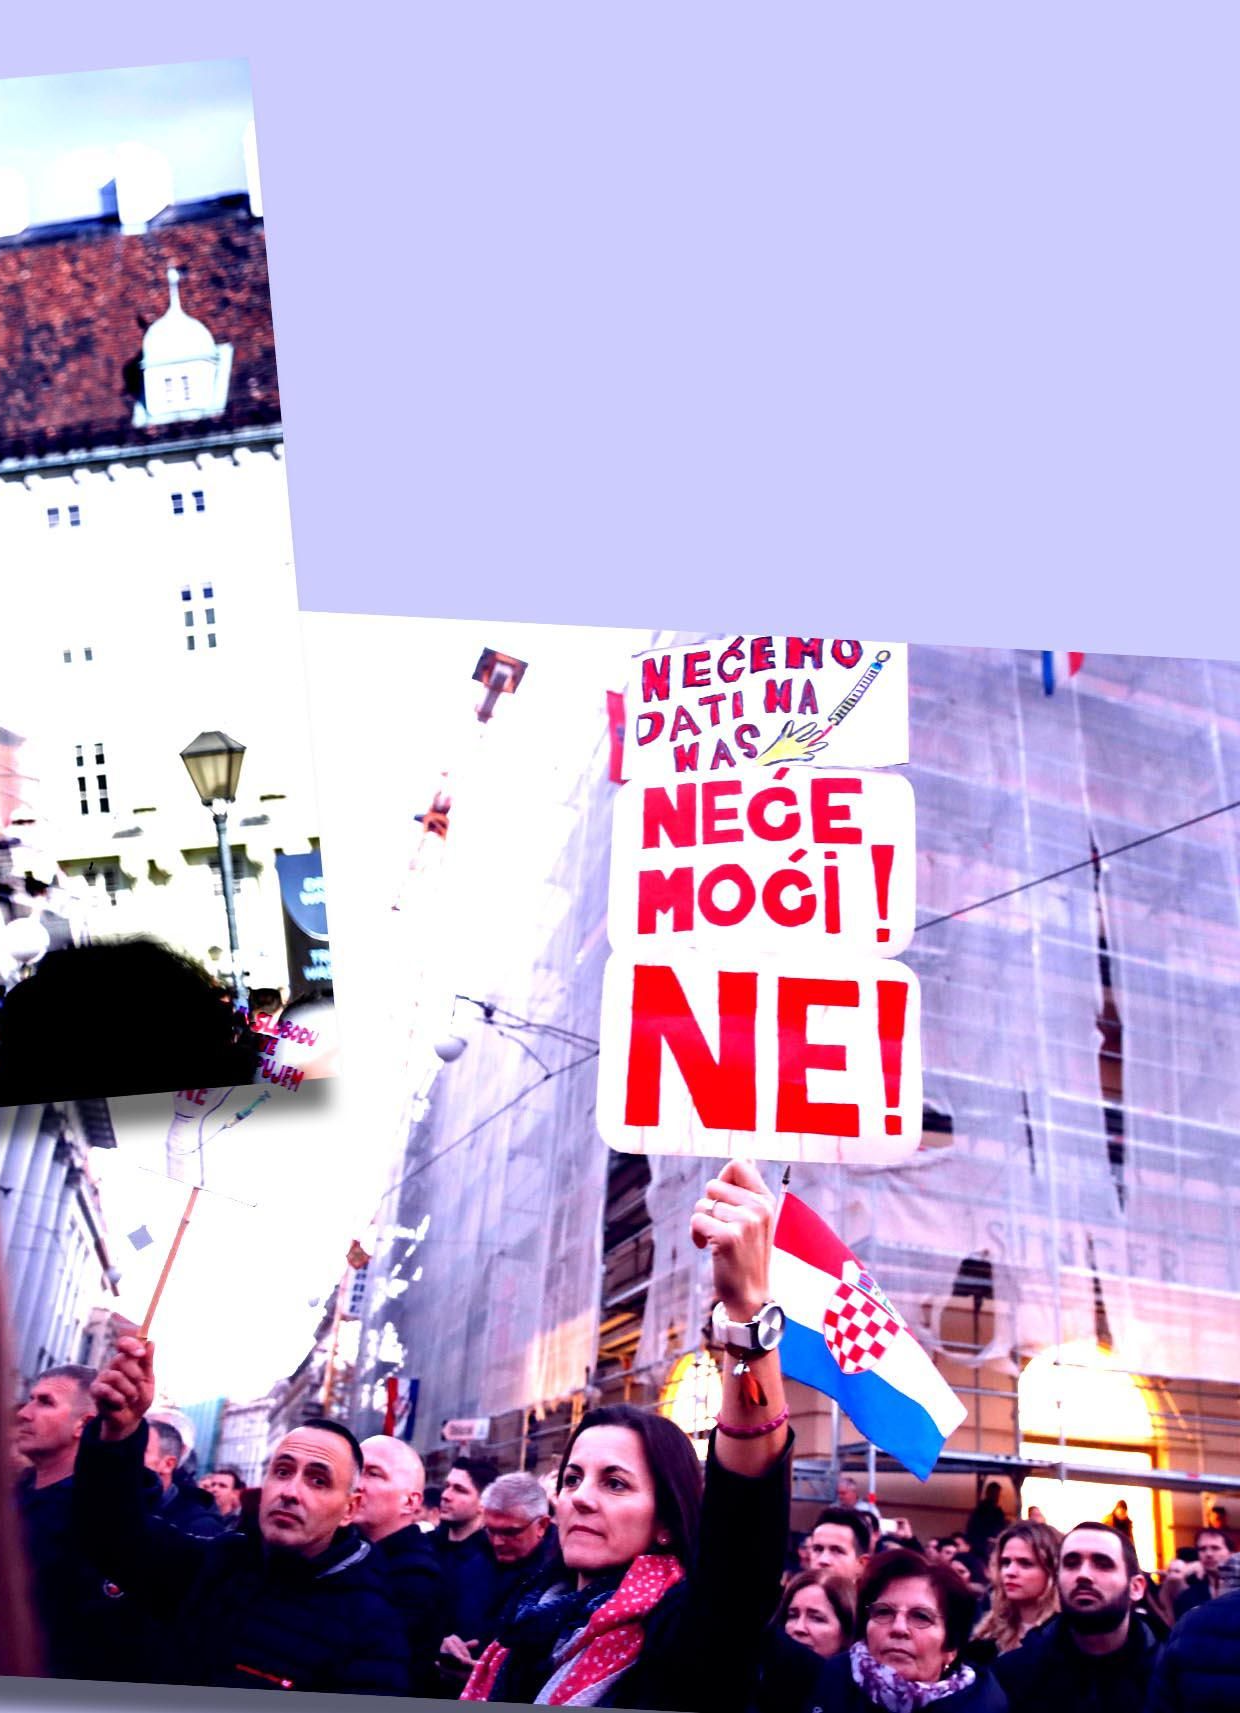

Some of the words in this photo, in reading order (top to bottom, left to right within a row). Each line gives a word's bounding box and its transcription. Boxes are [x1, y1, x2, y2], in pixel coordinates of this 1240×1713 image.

[641, 636, 863, 703] NEĆEMO
[636, 691, 744, 746] DATI
[763, 678, 819, 714] NA
[673, 724, 760, 772] NAS
[642, 767, 863, 849] NEĆE
[623, 964, 909, 1138] NE!
